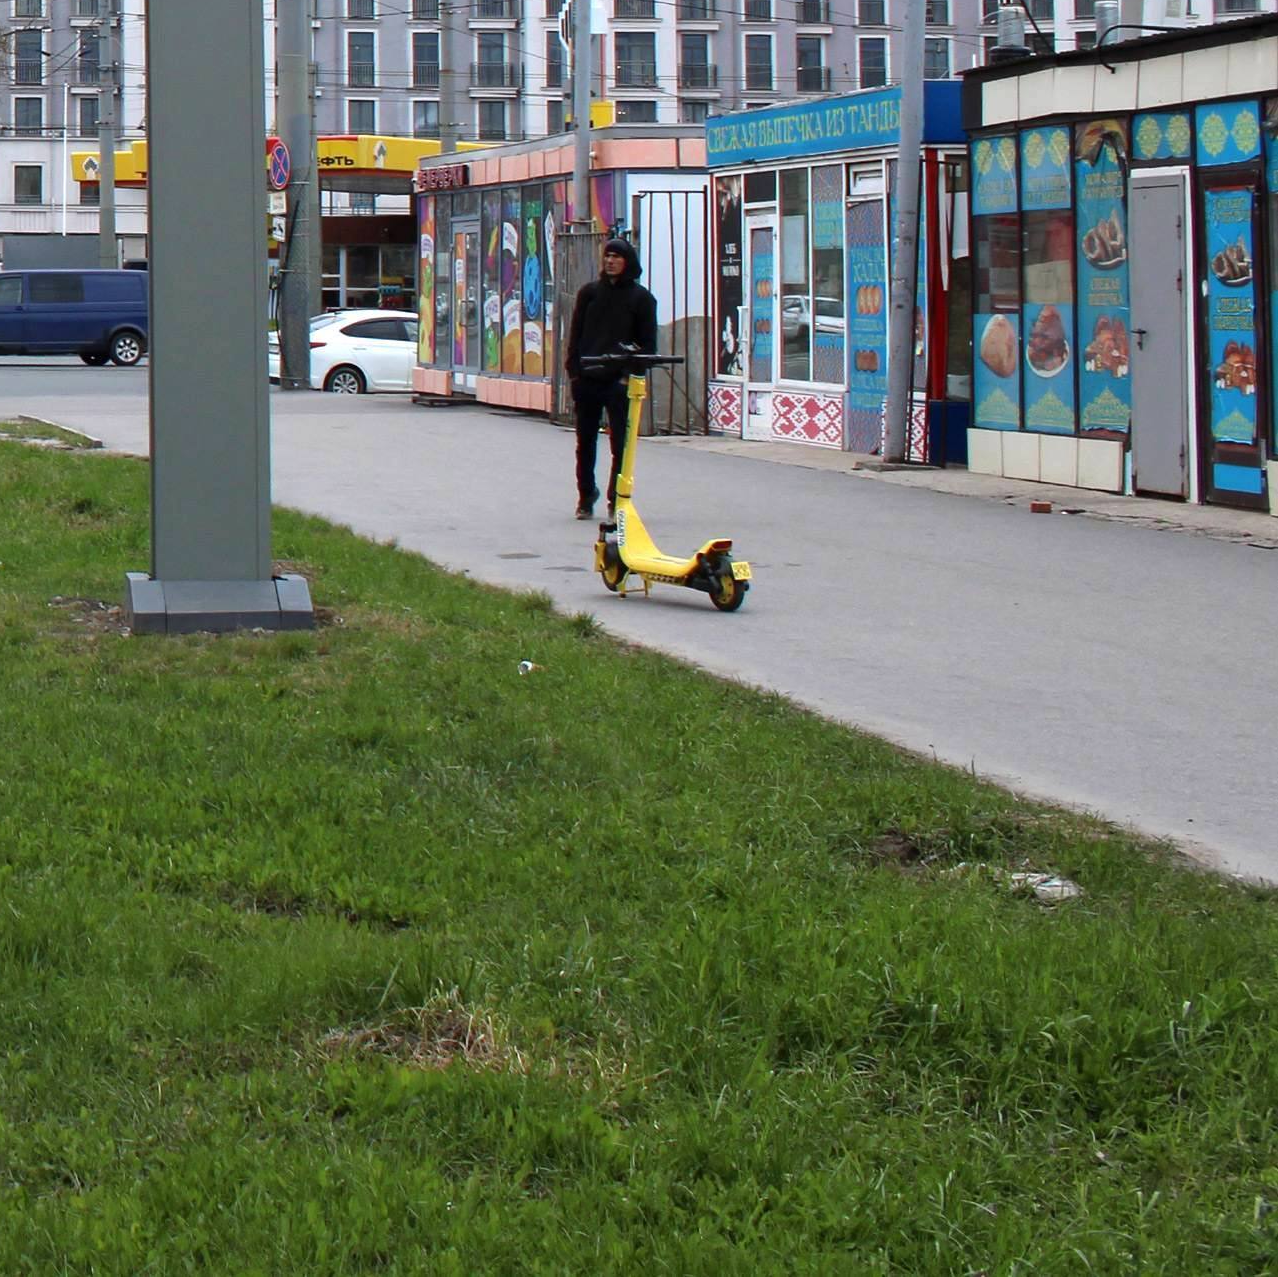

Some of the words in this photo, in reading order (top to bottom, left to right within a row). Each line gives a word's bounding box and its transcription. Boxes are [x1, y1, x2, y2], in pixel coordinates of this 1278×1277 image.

[707, 122, 757, 153] СВЕЖАЯ
[758, 113, 823, 147] ВЫПЕЧКА
[825, 107, 845, 138] ИЗ
[848, 99, 902, 135] ТАНДЫ
